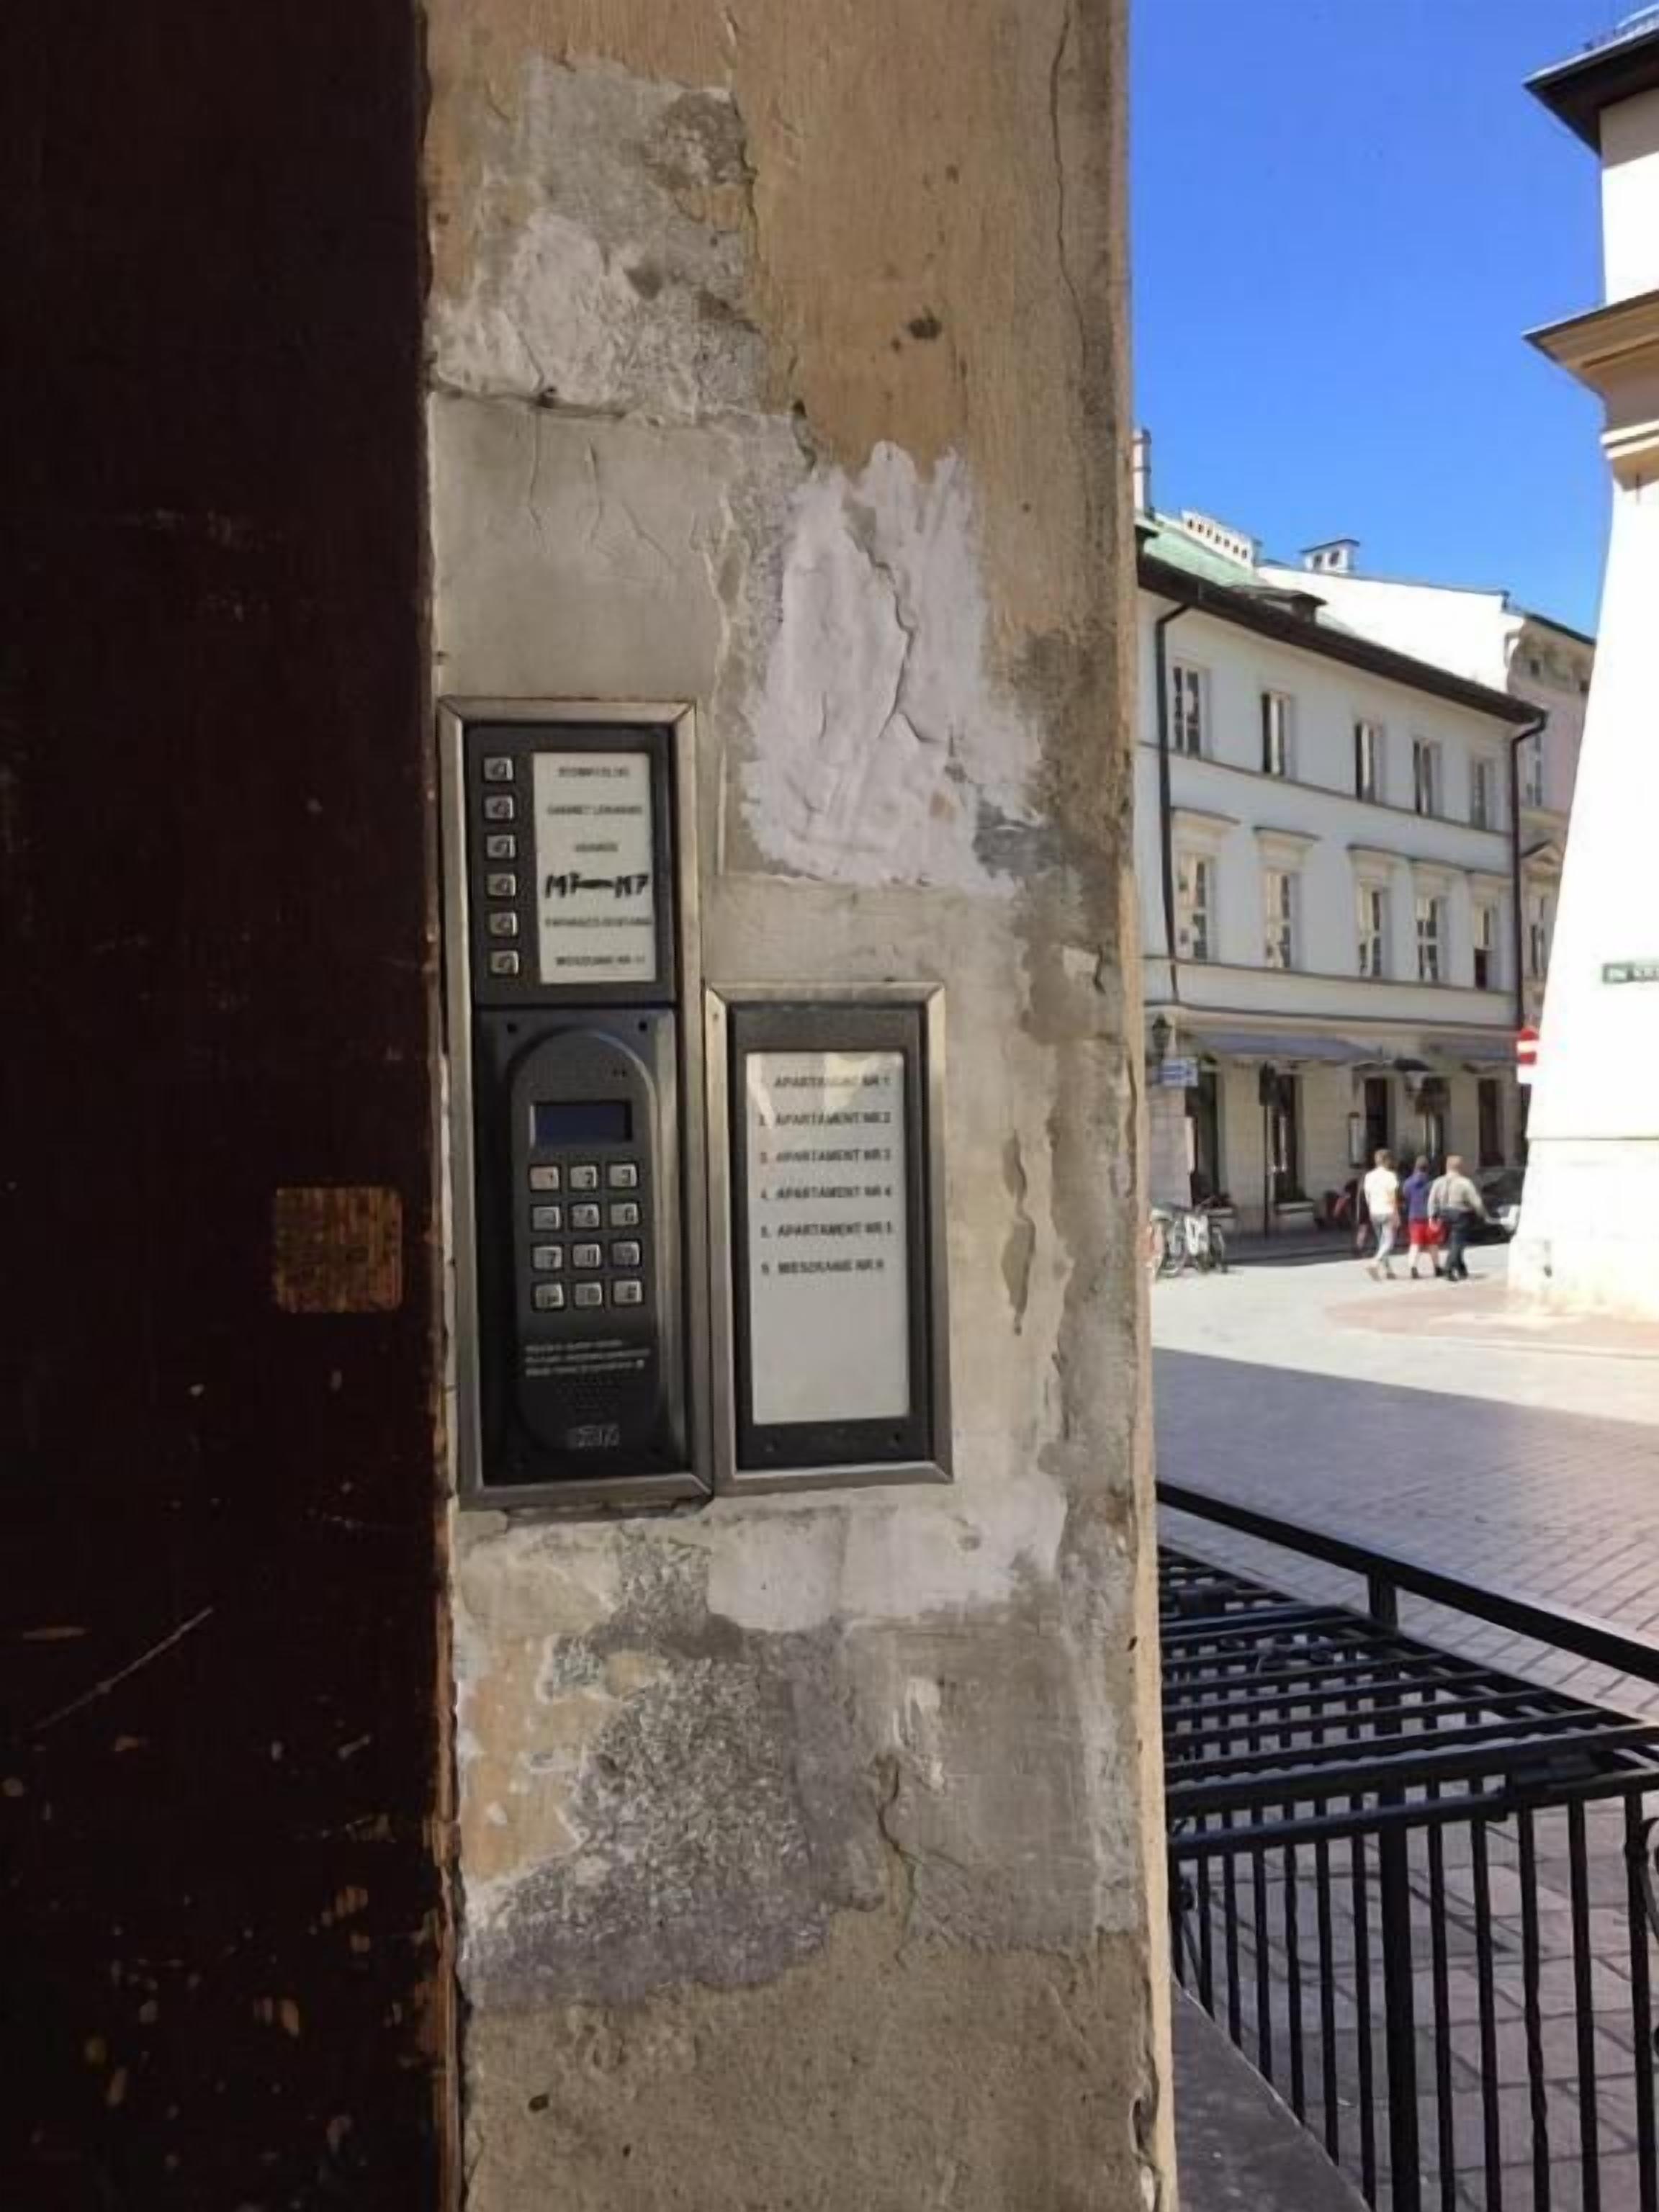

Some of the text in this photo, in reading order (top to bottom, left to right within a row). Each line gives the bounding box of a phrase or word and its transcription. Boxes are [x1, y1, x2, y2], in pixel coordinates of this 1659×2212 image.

[774, 1075, 858, 1088] APARTA
[775, 1148, 859, 1162] APARTAMENT
[776, 1186, 860, 1199] APARTAMENT
[778, 1222, 860, 1236] APARTAMENT
